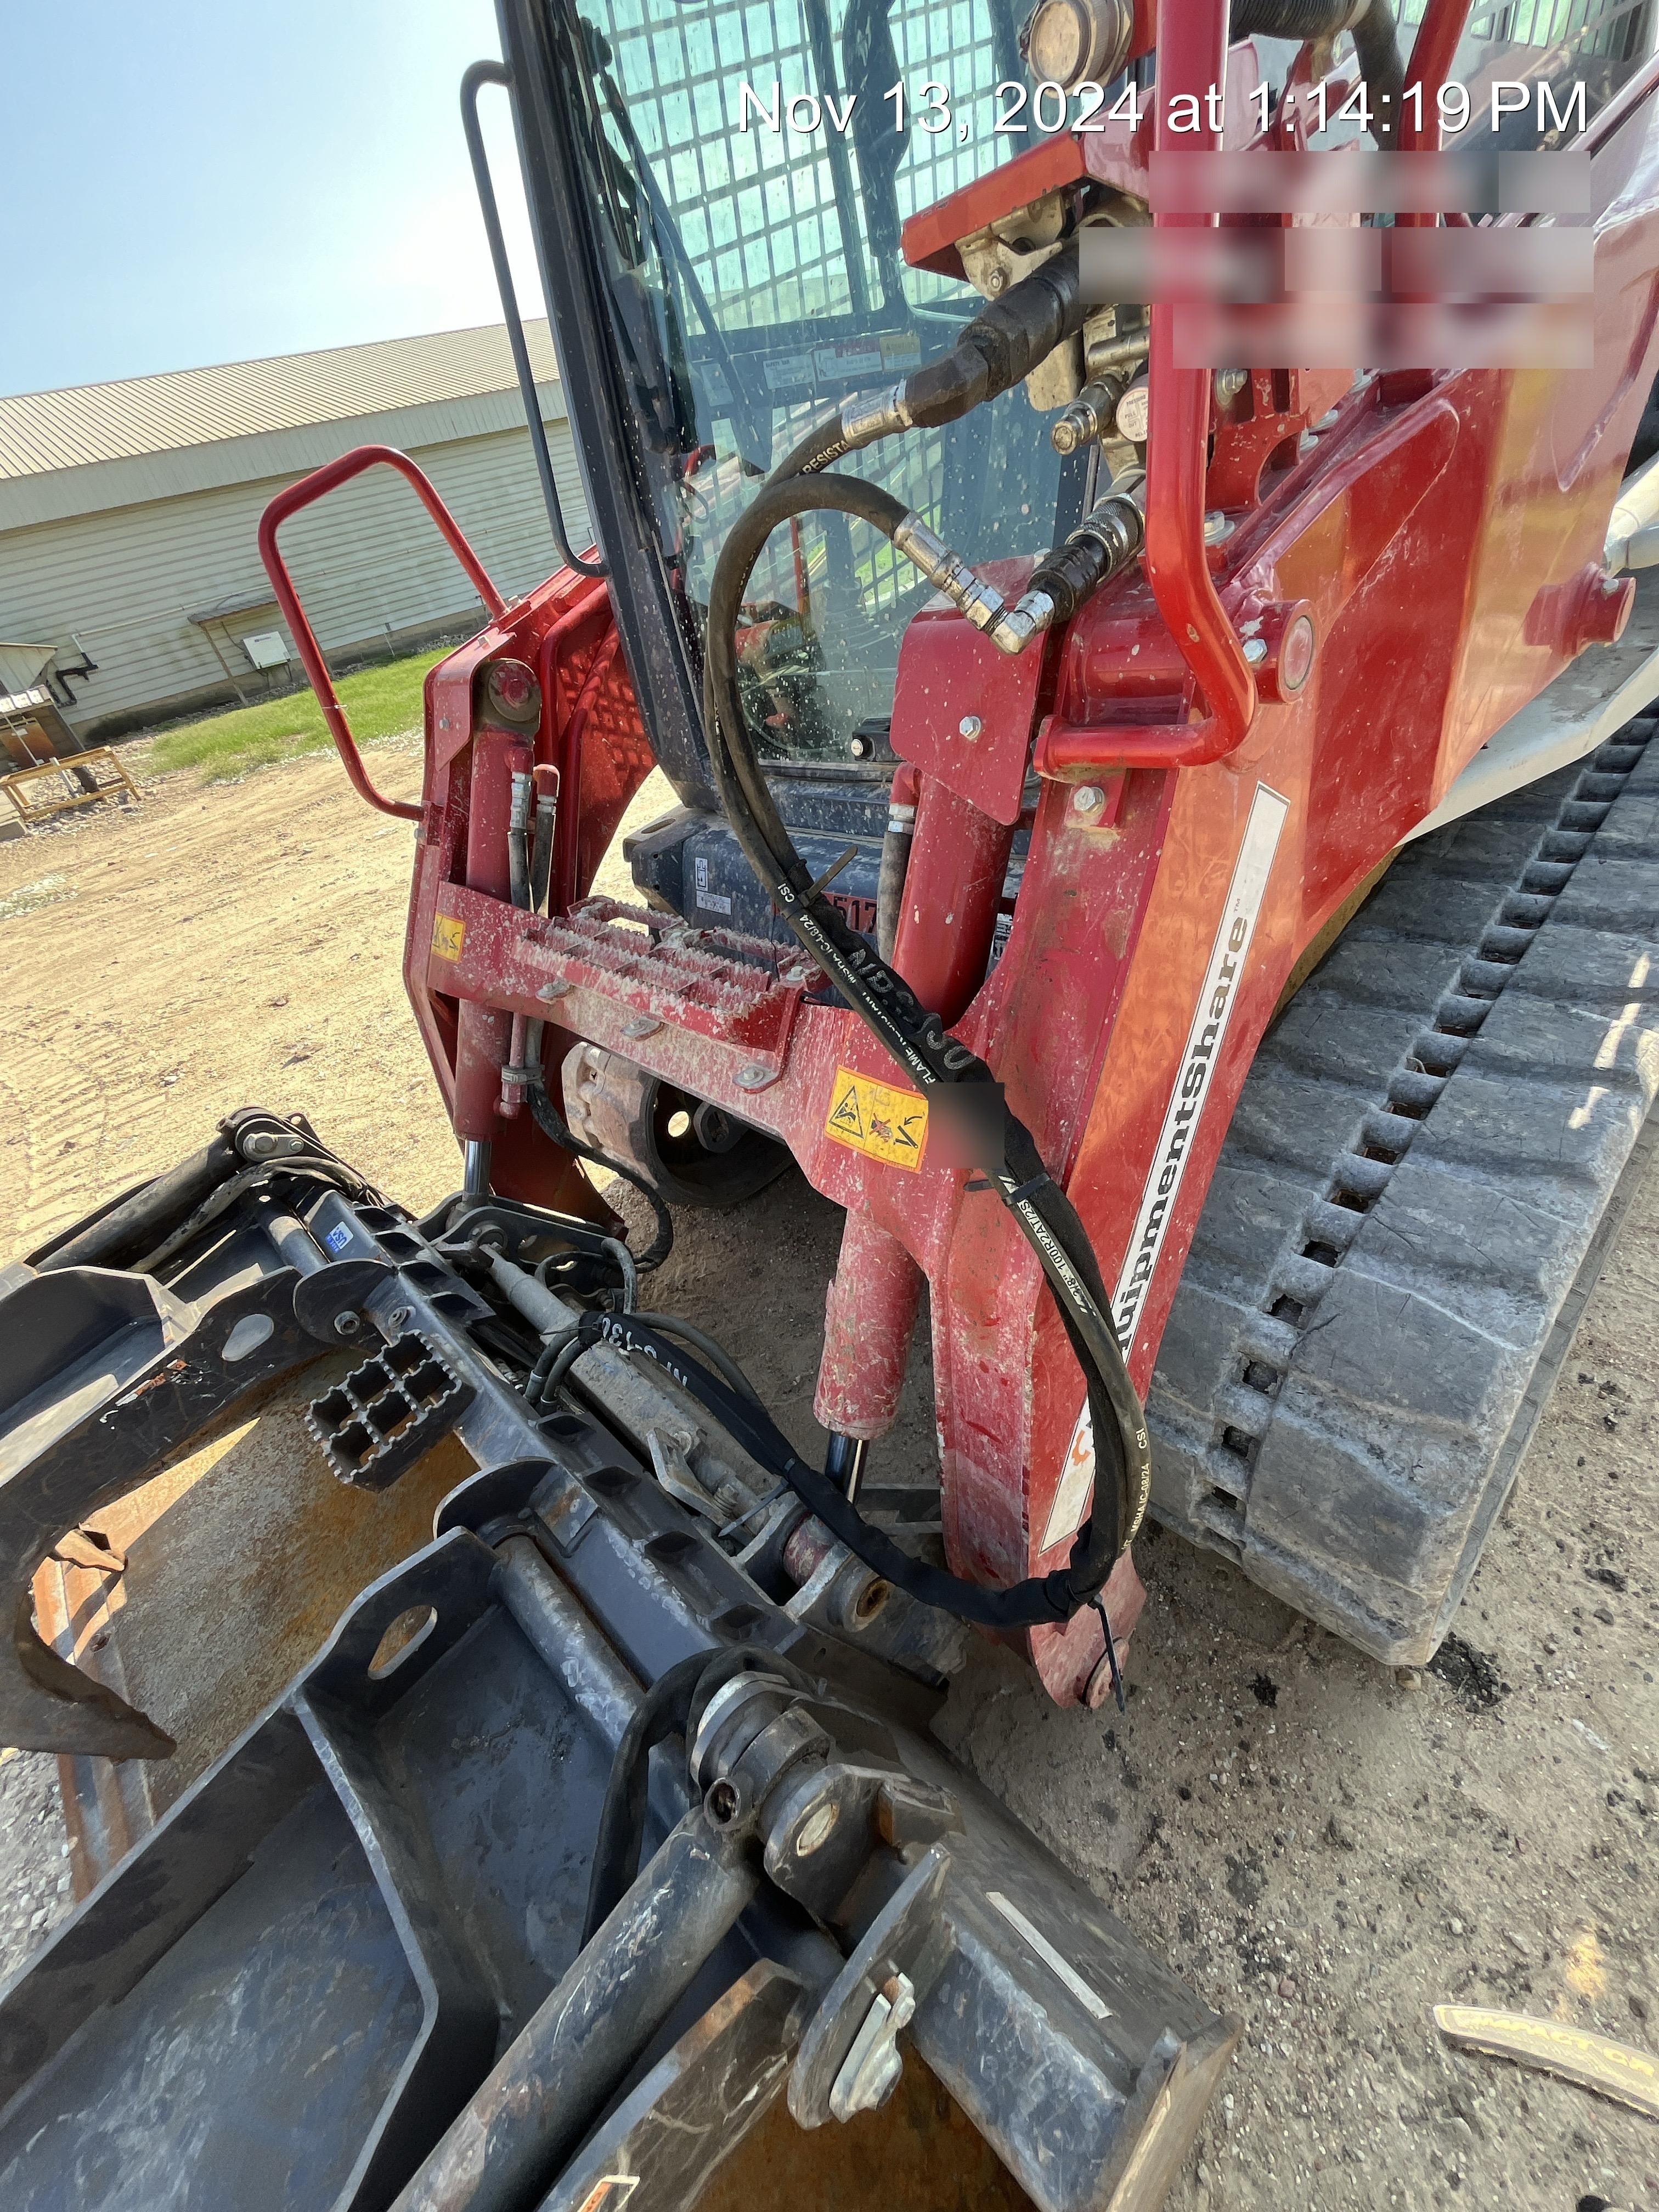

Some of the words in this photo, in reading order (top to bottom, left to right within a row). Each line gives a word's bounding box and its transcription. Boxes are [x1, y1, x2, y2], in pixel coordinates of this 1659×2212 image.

[777, 883, 795, 903] CSI
[905, 1047, 936, 1085] FLAME
[1085, 917, 1248, 1451] uipmentShare
[332, 1227, 347, 1247] USA
[1019, 1199, 1066, 1270] 100R2AT/2S
[1136, 1427, 1148, 1449] CSI
